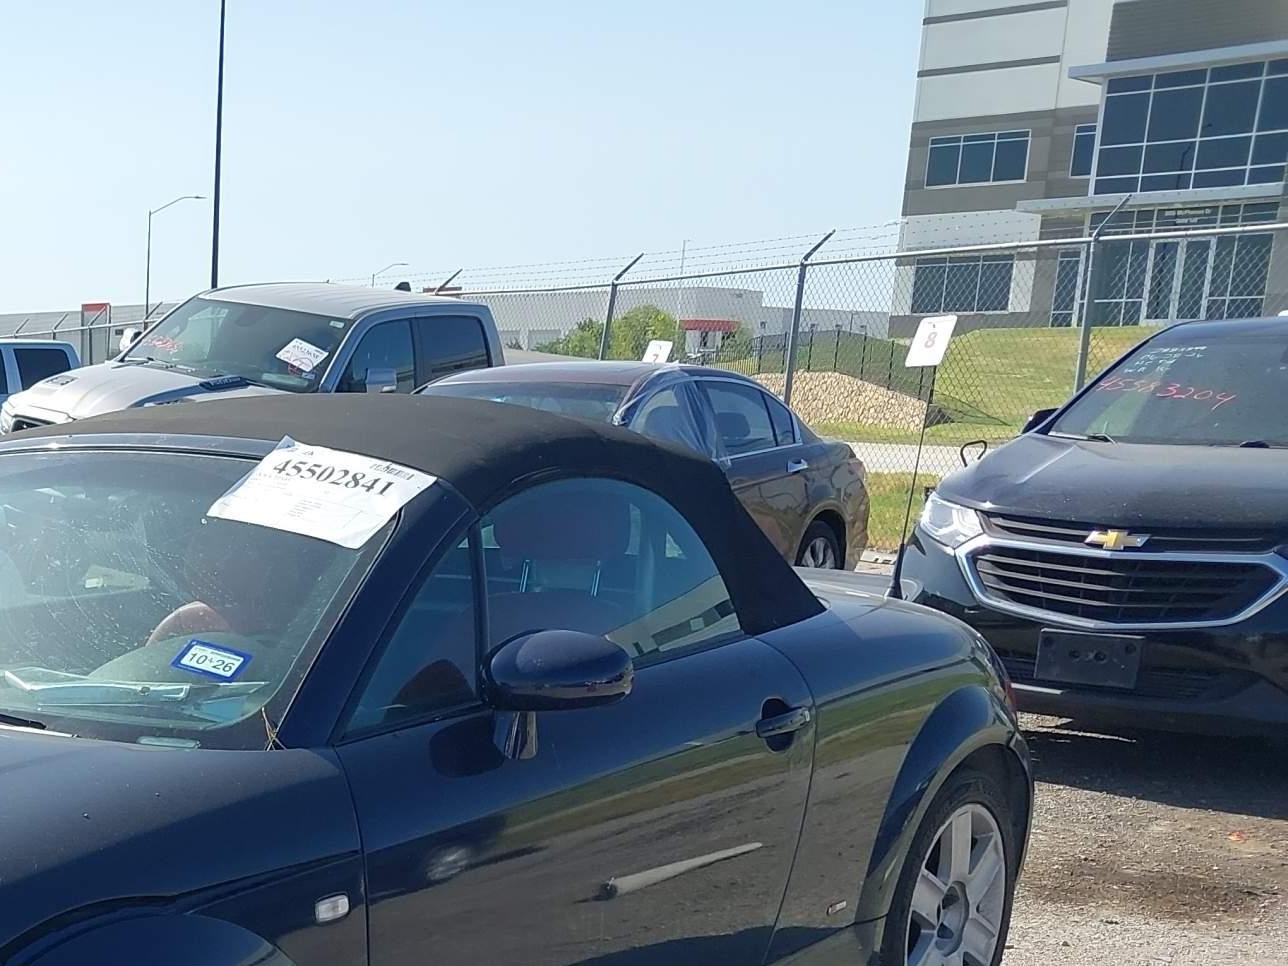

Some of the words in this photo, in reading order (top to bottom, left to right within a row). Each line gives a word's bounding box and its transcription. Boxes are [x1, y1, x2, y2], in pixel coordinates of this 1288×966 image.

[924, 331, 938, 348] 8
[273, 458, 396, 497] 45502841
[189, 652, 208, 665] 10
[212, 659, 235, 672] 26
